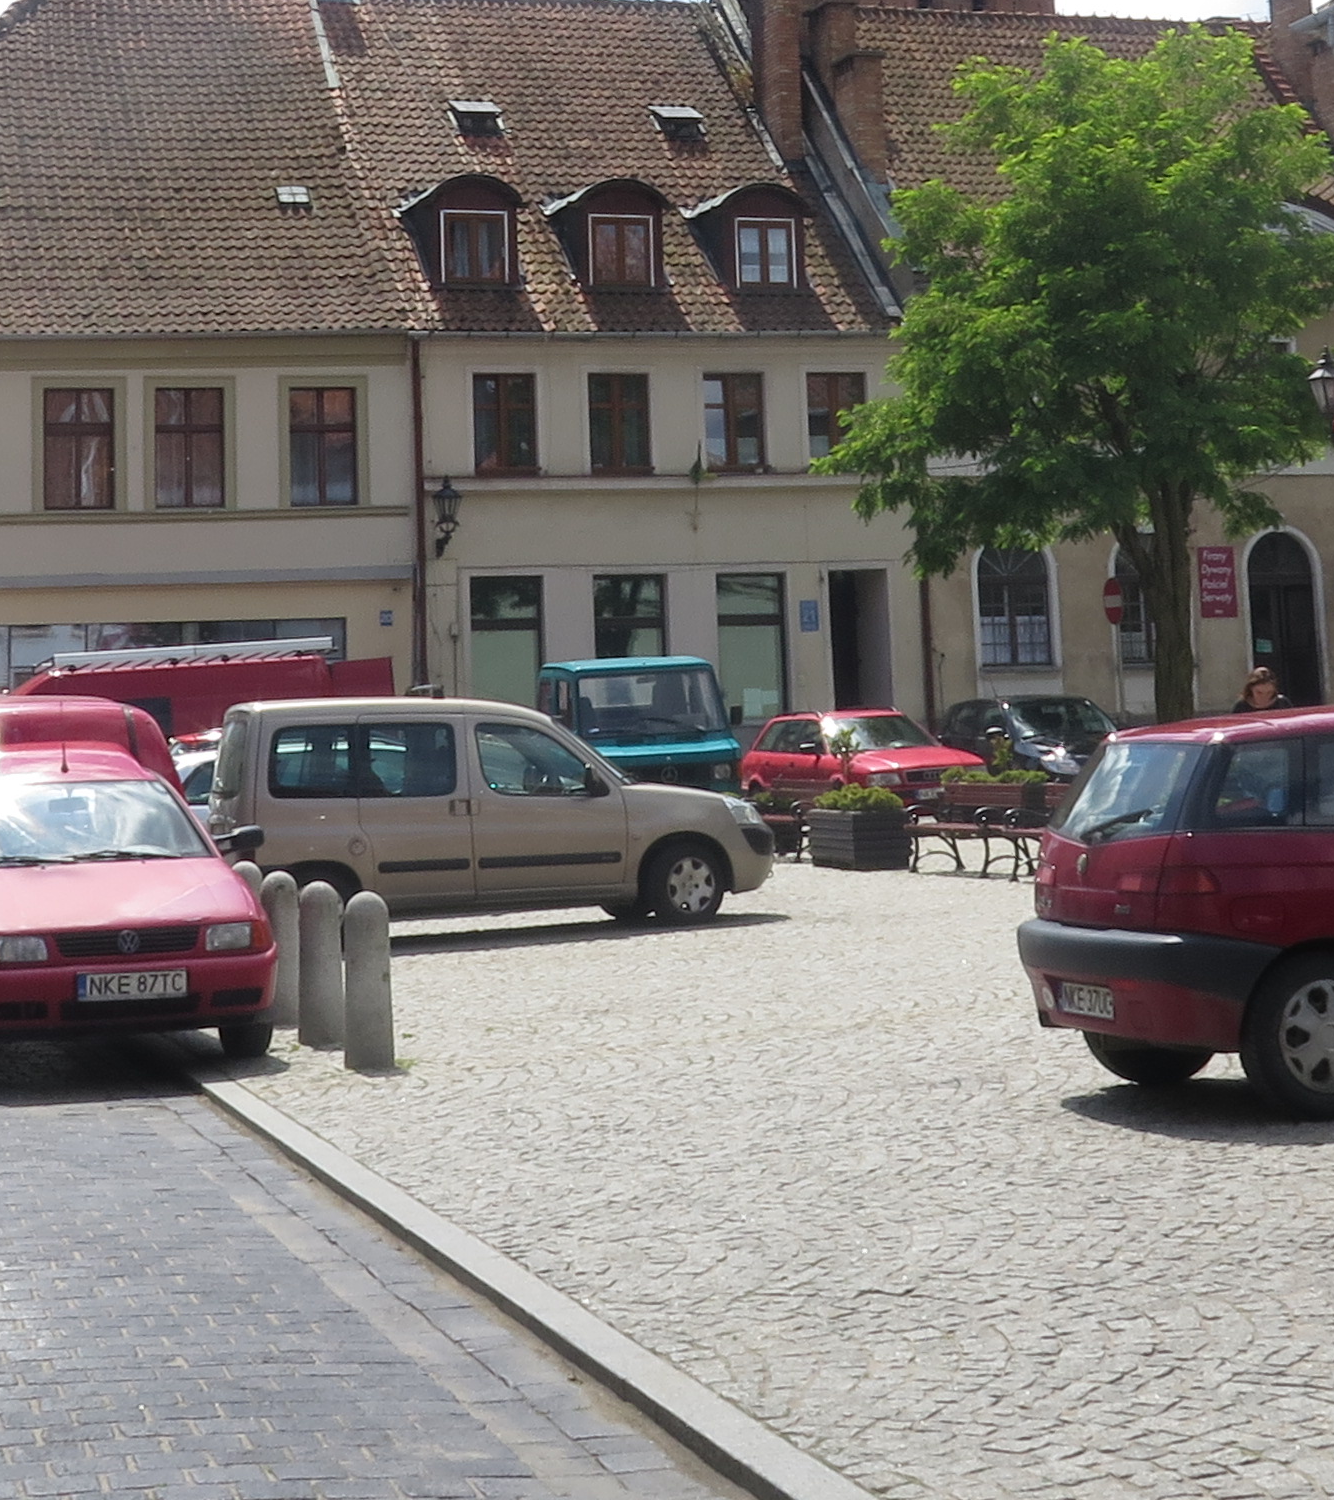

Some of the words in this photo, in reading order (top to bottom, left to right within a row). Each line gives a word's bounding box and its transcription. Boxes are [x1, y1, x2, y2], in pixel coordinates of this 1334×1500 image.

[1201, 564, 1232, 576] Dywany
[89, 975, 130, 996] NKE
[137, 973, 183, 993] 87TC
